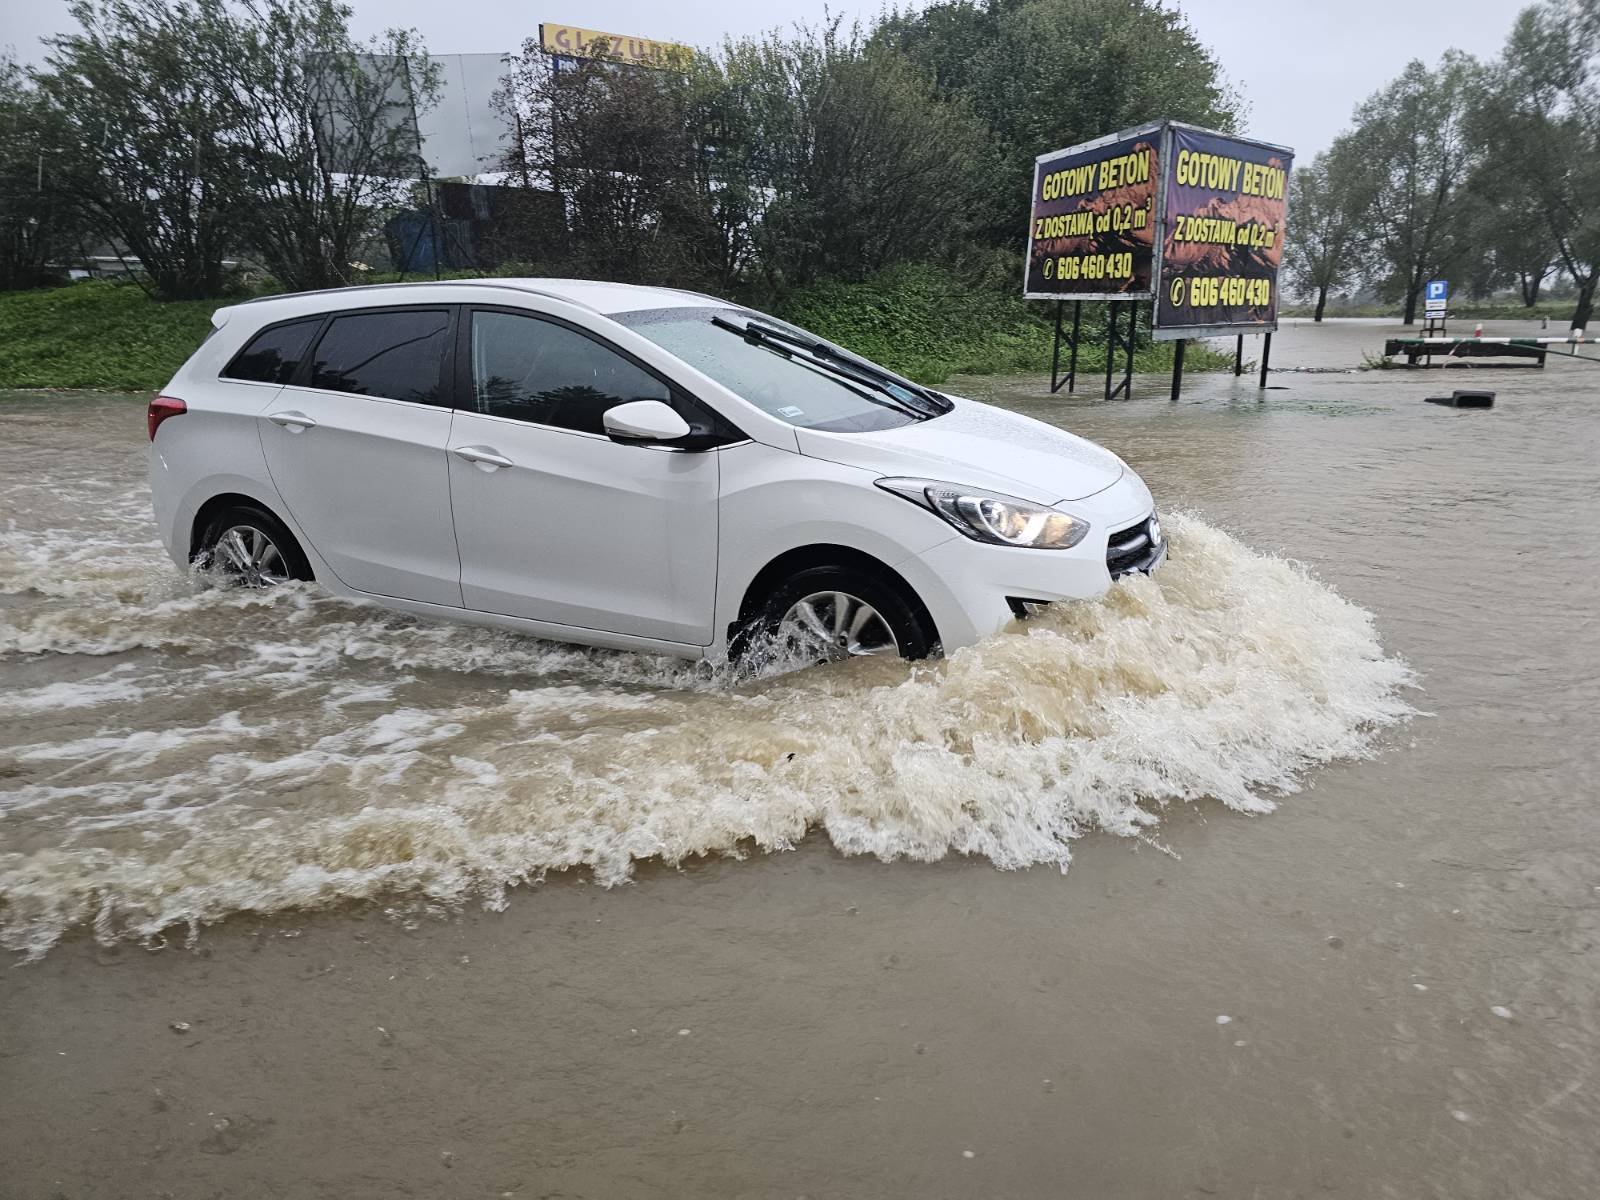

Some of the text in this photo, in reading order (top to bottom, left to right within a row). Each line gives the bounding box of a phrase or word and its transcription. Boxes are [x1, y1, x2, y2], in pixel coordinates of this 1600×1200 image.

[1042, 150, 1150, 201] GOTOWY BETON
[1176, 150, 1285, 200] GOTOWY BETON
[1034, 218, 1044, 240] Z
[1044, 211, 1094, 240] DOSTAWĄ
[1096, 208, 1112, 233] od
[1113, 205, 1132, 235] 0,2
[1174, 216, 1185, 241] Z
[1185, 217, 1236, 250] DOSTAWĄ
[1237, 224, 1250, 245] od
[1250, 224, 1265, 250] 0,2
[1057, 252, 1132, 280] 606 460 430
[1190, 277, 1270, 307] 606 460 430
[1430, 283, 1444, 298] P
